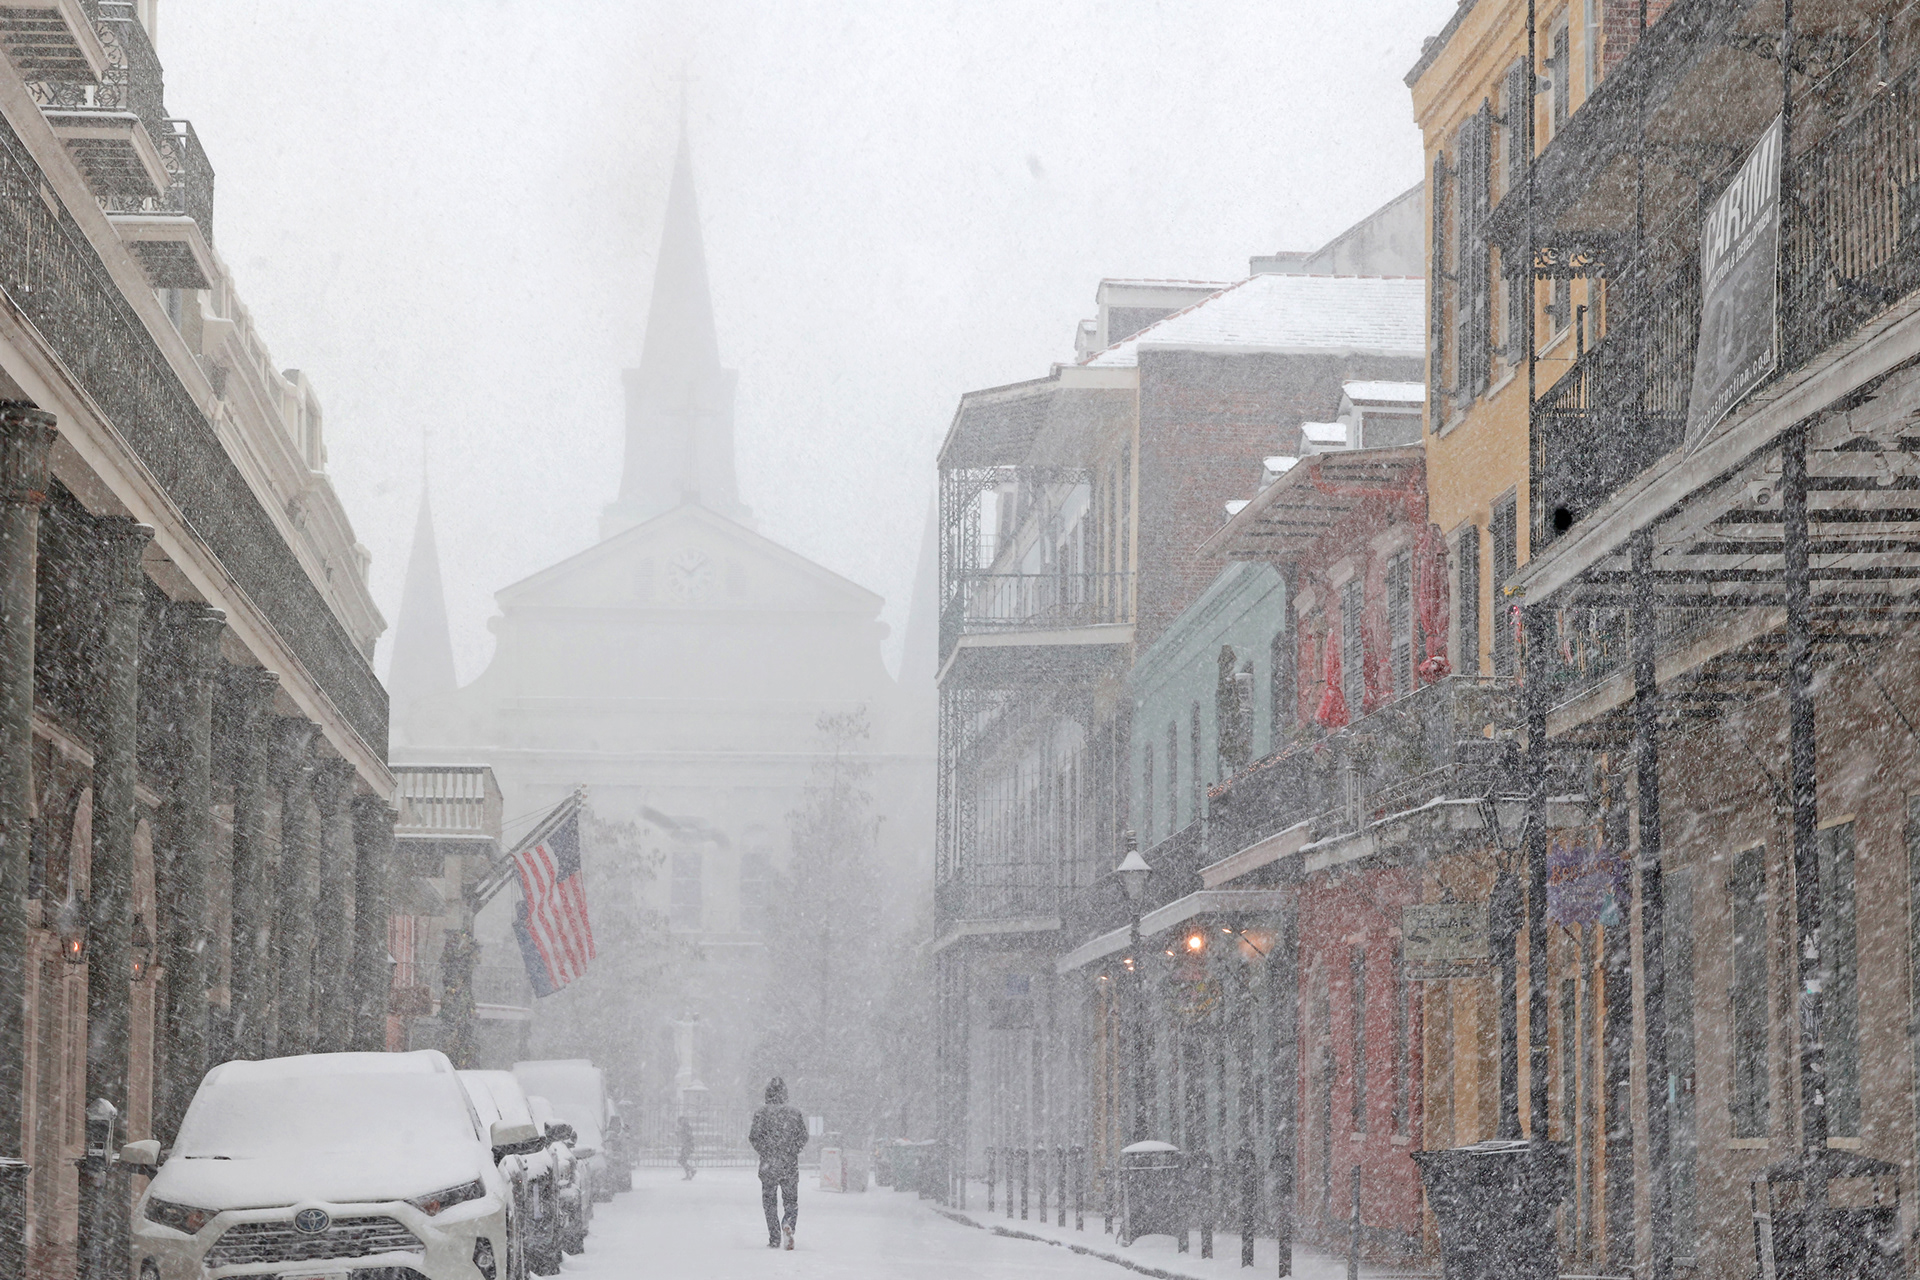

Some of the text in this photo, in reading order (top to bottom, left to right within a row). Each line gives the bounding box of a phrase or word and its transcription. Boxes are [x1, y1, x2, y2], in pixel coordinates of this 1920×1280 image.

[1705, 127, 1777, 282] CARIMI
[1729, 251, 1736, 269] &
[1736, 202, 1774, 263] DEVELOPMENT
